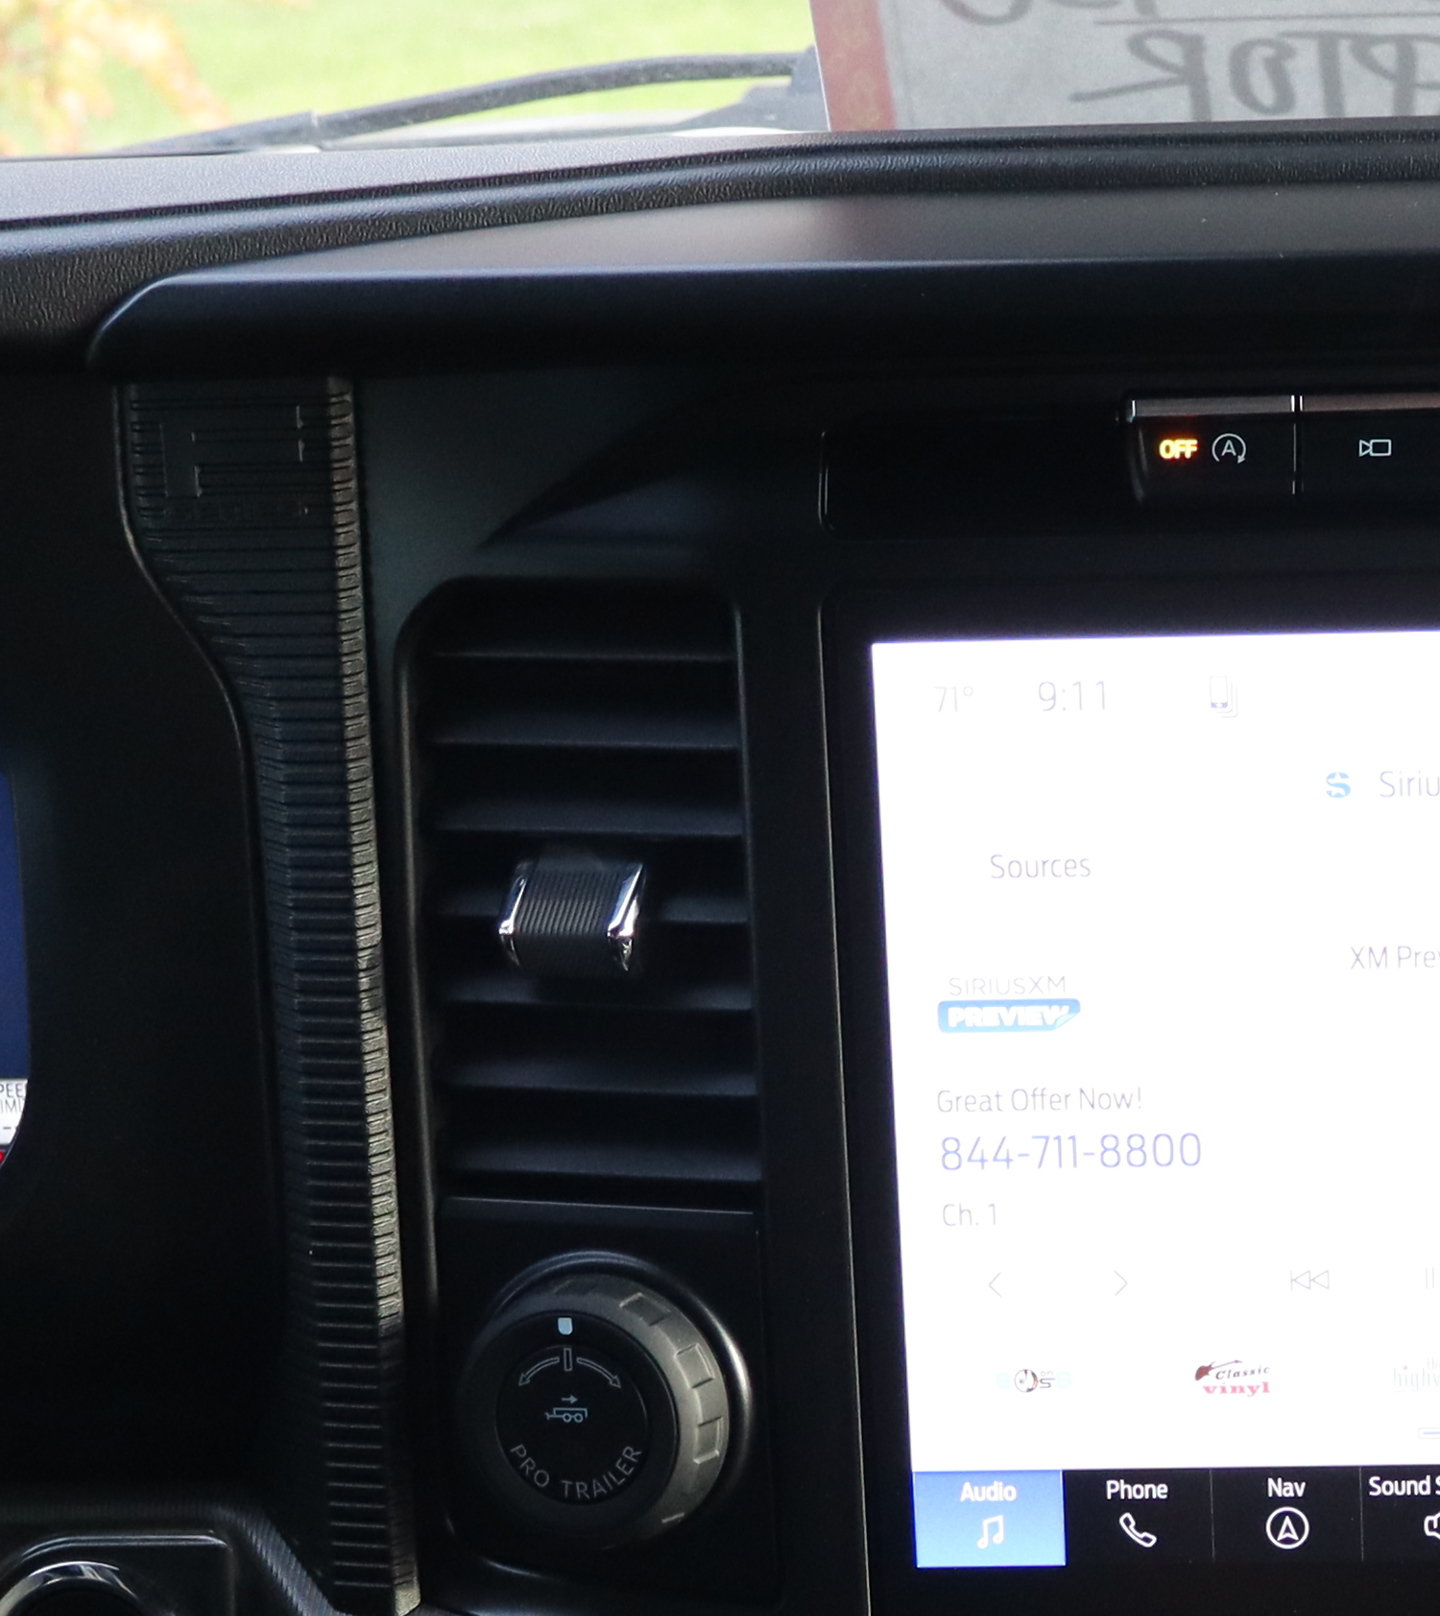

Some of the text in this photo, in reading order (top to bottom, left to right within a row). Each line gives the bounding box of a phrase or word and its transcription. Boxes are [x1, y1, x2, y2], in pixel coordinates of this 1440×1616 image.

[1158, 437, 1200, 460] OFF
[1038, 680, 1111, 713] 9:11
[989, 854, 1092, 880] Sources
[1349, 947, 1389, 970] XM
[936, 1086, 1144, 1113] Great Offer Now!
[940, 1132, 1203, 1171] 844-711-8800
[942, 1202, 998, 1228] Ch. 1
[510, 1443, 642, 1500] PRO TRAILER
[960, 1482, 1017, 1502] Audio
[1106, 1480, 1168, 1500] Phone
[1268, 1479, 1306, 1499] Nav
[1369, 1475, 1431, 1497] Sound
